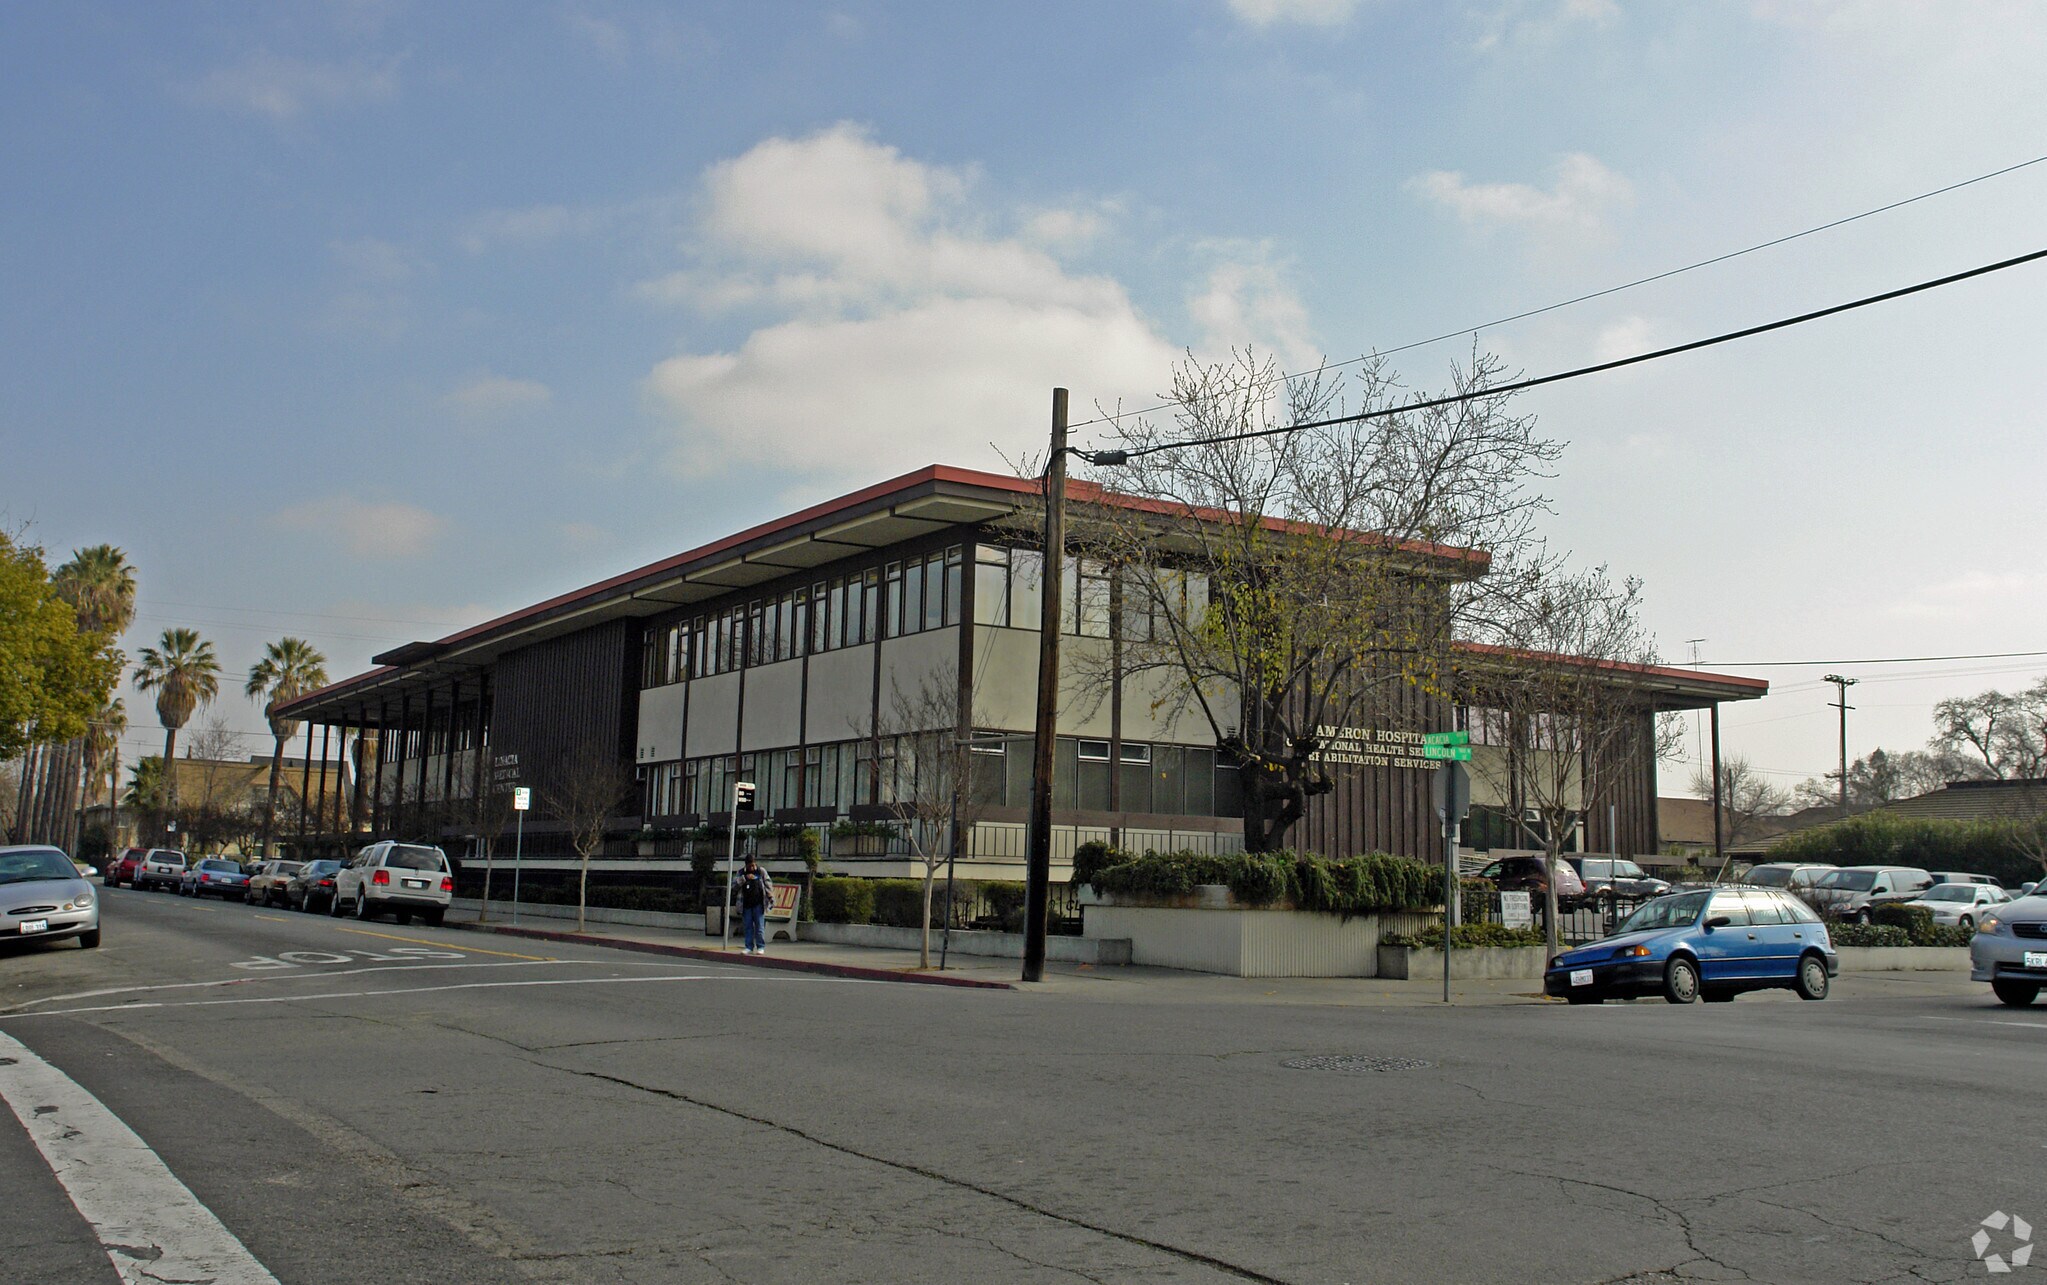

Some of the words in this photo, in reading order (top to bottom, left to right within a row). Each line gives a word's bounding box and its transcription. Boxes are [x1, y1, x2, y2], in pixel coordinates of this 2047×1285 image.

[1315, 724, 1371, 741] AMERON
[1375, 729, 1427, 745] HOSPITA
[1428, 735, 1450, 745] ACACIA
[1365, 743, 1405, 756] HEALTH
[1425, 747, 1456, 759] LINCOLN
[1394, 757, 1441, 770] SERVICES
[229, 948, 467, 970] STOP
